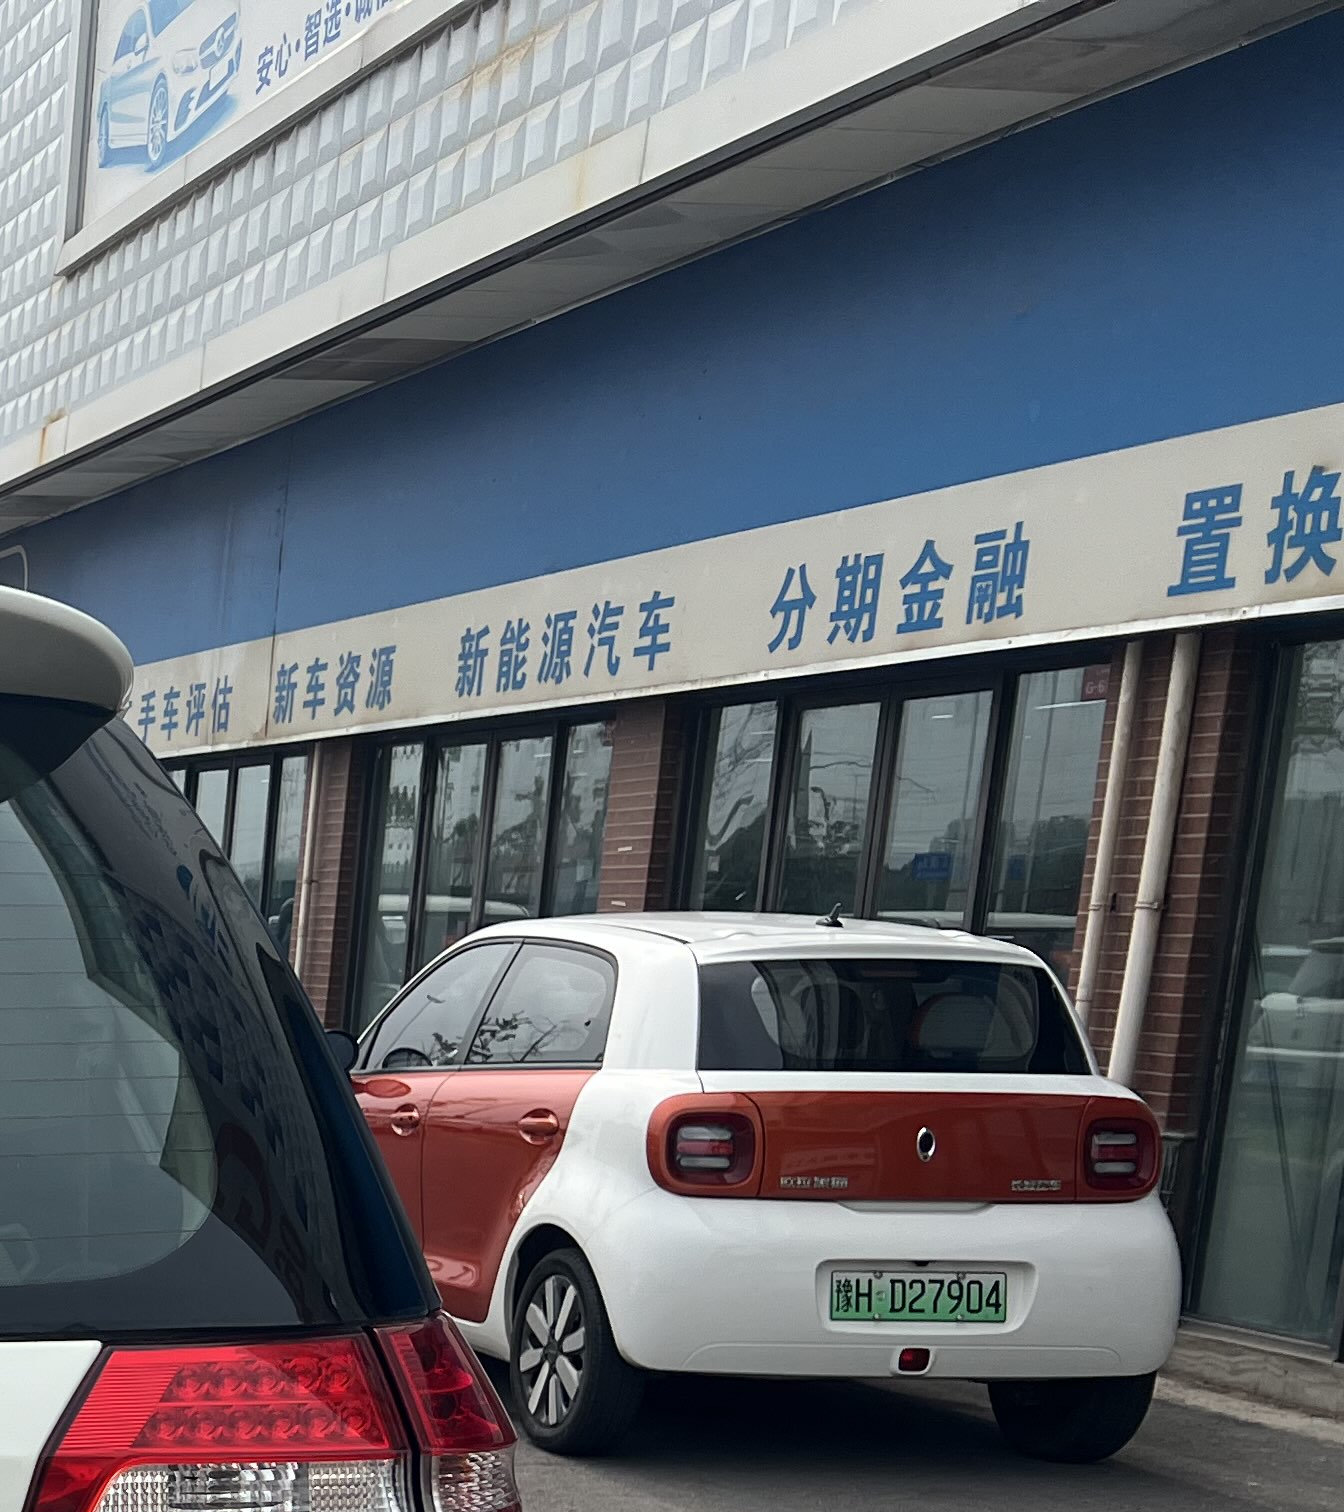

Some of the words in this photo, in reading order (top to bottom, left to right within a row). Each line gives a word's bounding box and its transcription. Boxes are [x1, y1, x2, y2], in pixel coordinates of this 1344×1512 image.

[256, 0, 394, 95] 安心·智选·
[128, 675, 233, 744] 手车评估
[274, 646, 397, 724] 新车资源
[455, 590, 676, 698] 新能源汽车
[767, 520, 1031, 654] 分期金融
[1167, 465, 1343, 597] 置换
